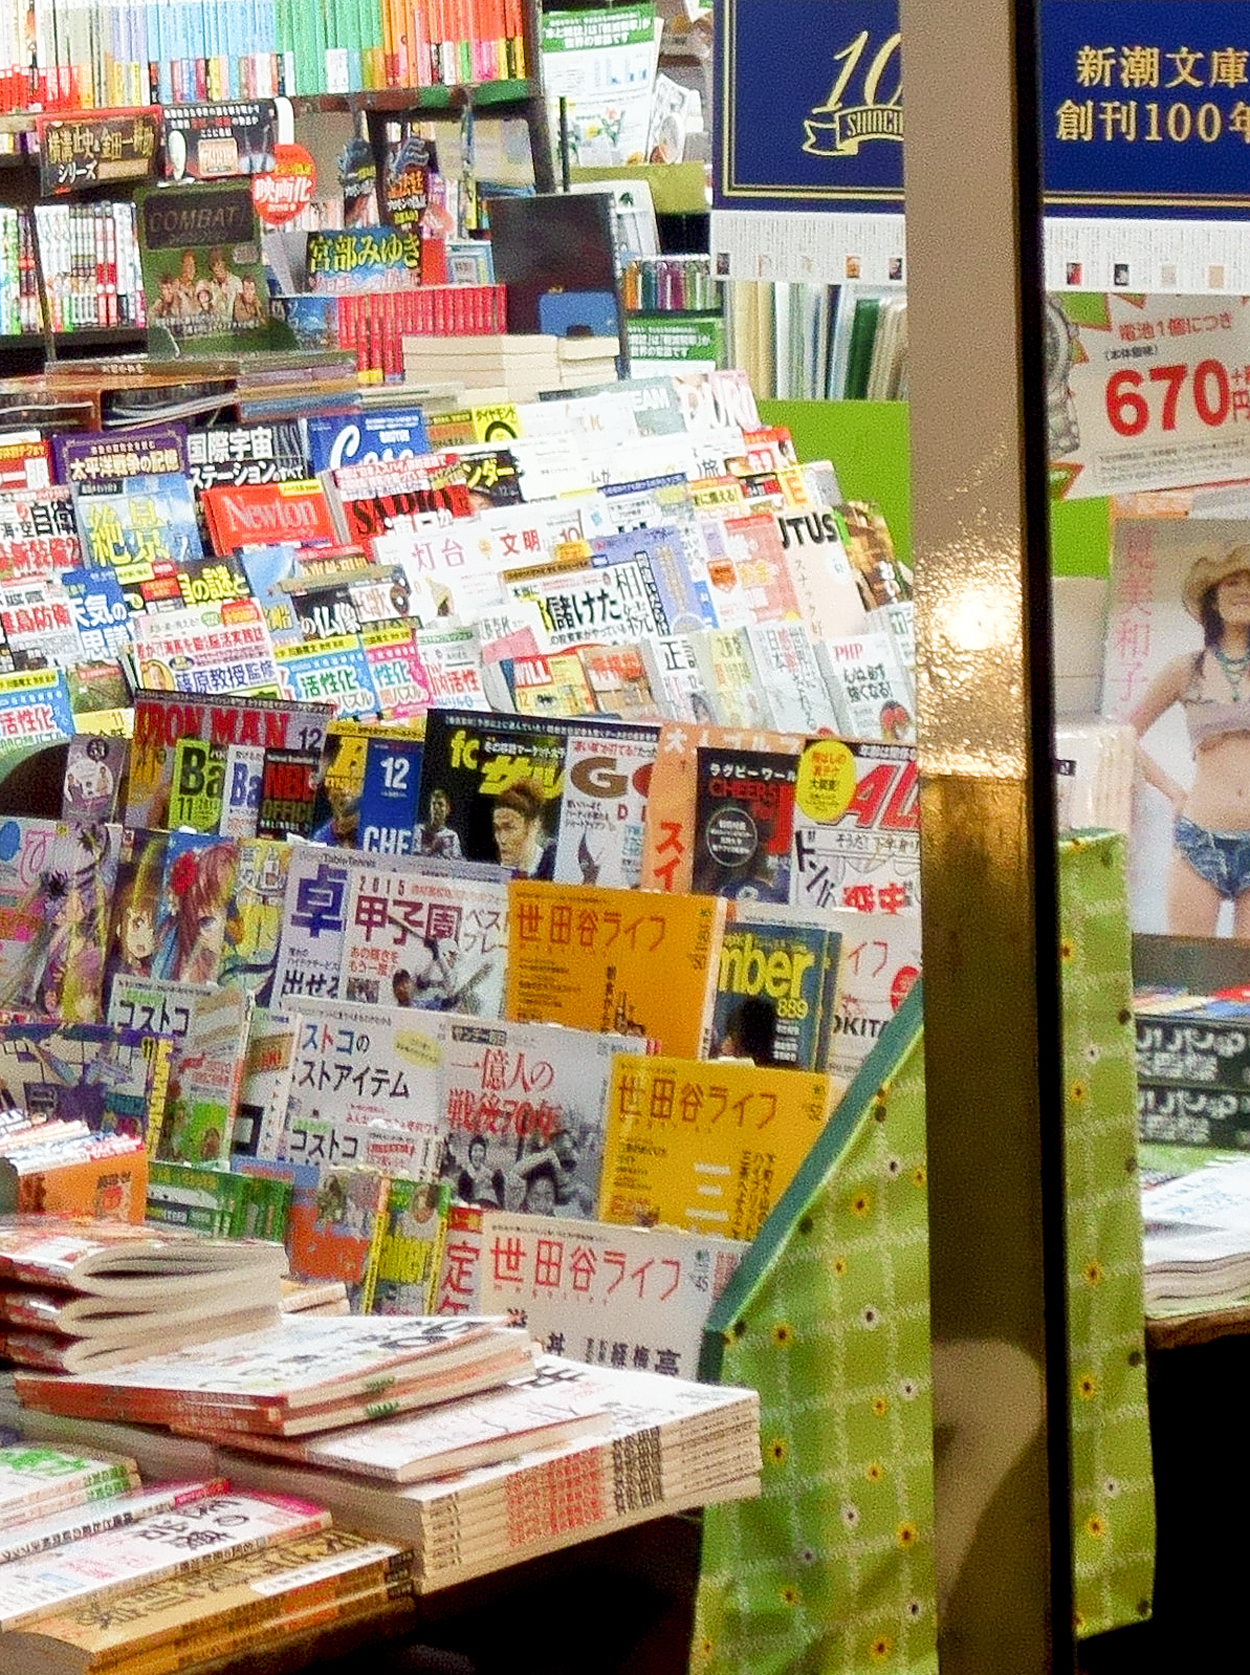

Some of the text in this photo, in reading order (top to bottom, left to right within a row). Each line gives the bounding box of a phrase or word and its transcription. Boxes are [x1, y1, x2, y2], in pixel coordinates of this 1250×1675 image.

[1076, 45, 1250, 90] 新潮文庫
[847, 110, 904, 137] SHINCH
[58, 160, 99, 183] シリーズ
[254, 178, 310, 205] 映画化
[309, 233, 421, 274] 宮部みゆき
[1105, 358, 1231, 438] 670
[186, 426, 274, 464] 国際宇宙
[70, 450, 180, 481] 太平洋戦争の記憶
[225, 493, 319, 533] Newton
[411, 541, 466, 573] 灯台
[499, 528, 543, 556] 文明
[834, 642, 864, 661] PHP
[299, 666, 357, 700] 活性化
[134, 702, 291, 748] IRON MAN
[299, 725, 325, 751] 12
[379, 755, 412, 790] 12
[358, 875, 406, 895] 2015
[354, 894, 464, 946] 甲子園
[516, 904, 667, 952] 世田谷ライフ
[118, 1000, 191, 1038] コストコ
[617, 1074, 778, 1130] 世田谷ライフ
[290, 1128, 359, 1161] コストコ
[489, 1237, 681, 1301] 世田谷ライフ
